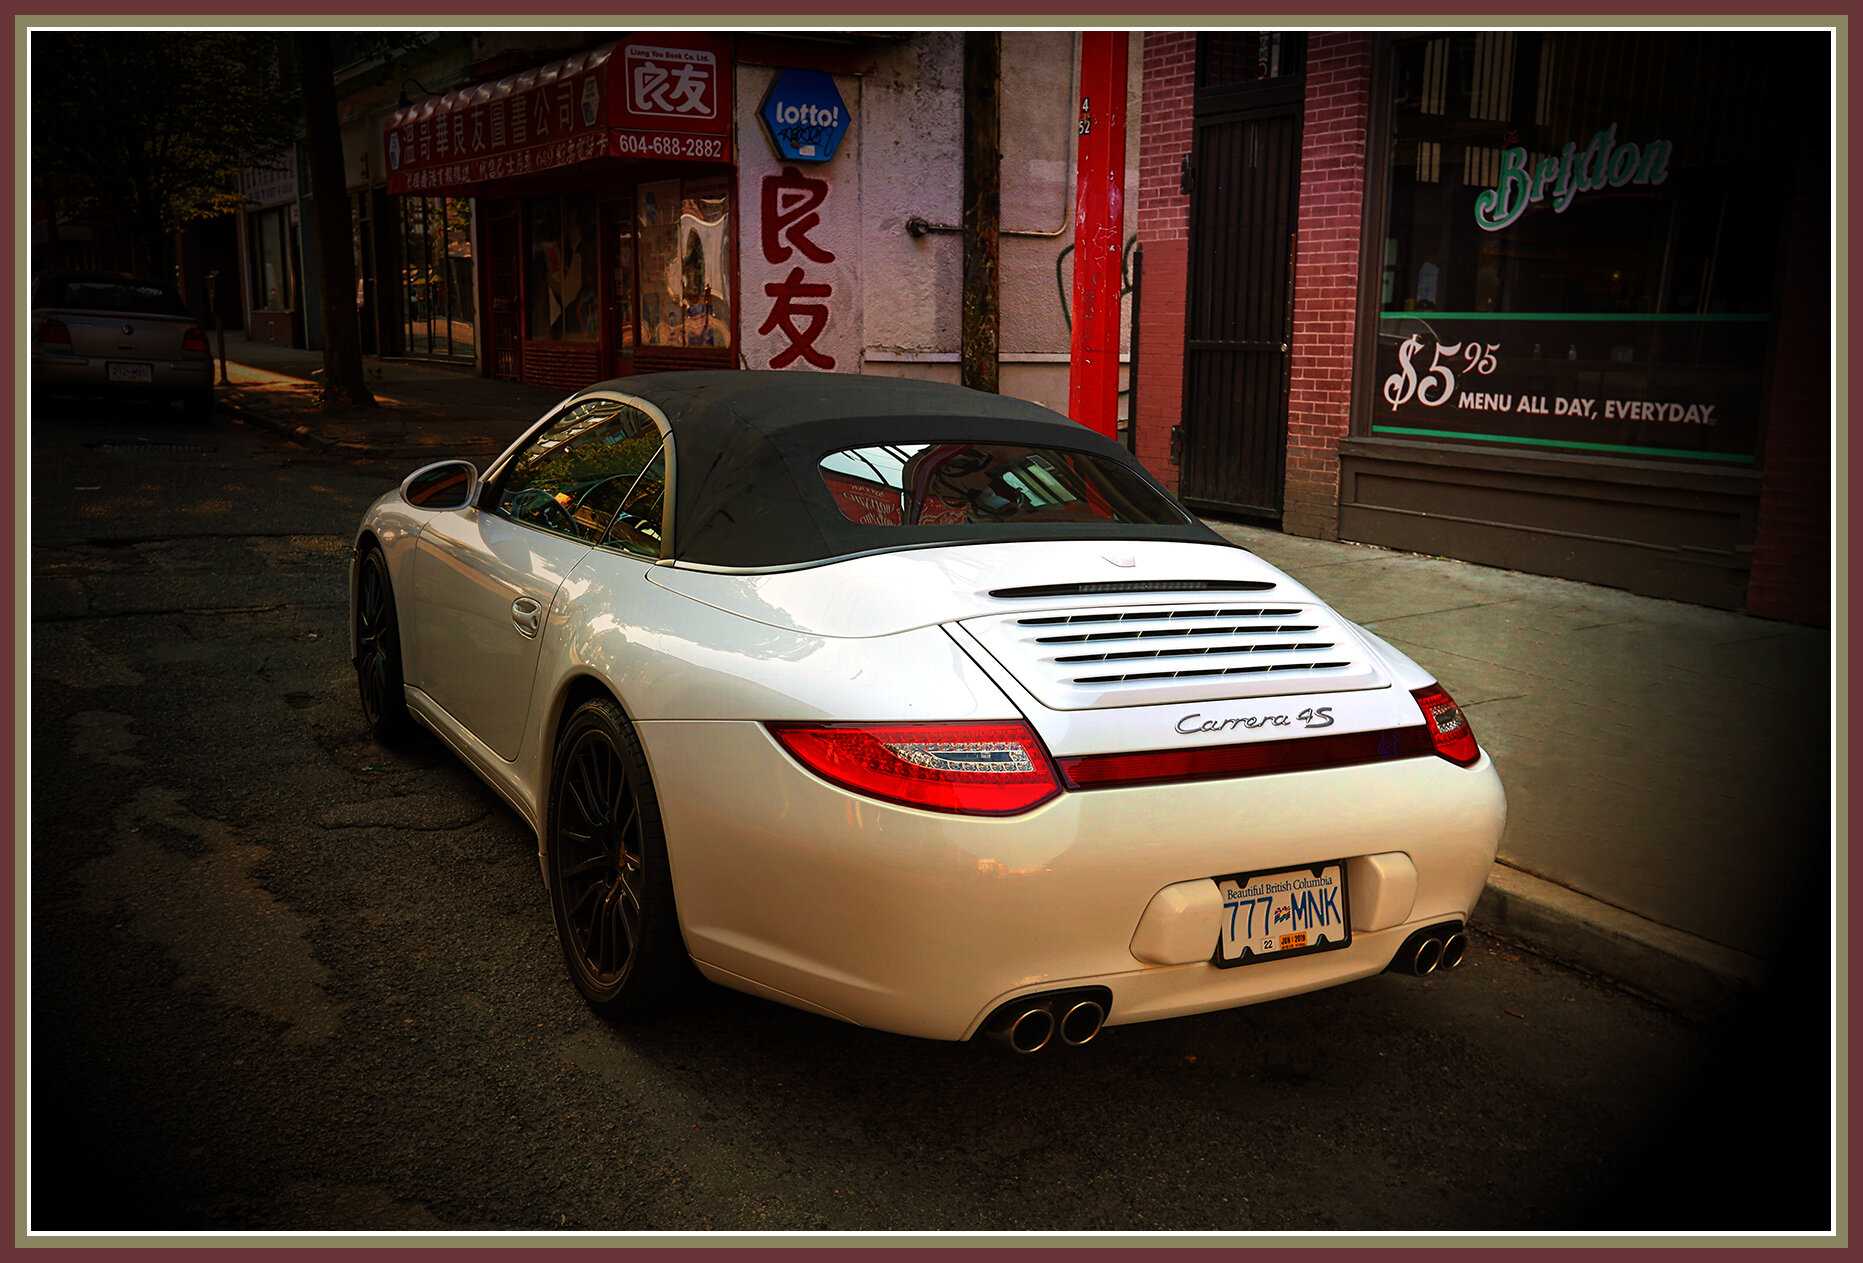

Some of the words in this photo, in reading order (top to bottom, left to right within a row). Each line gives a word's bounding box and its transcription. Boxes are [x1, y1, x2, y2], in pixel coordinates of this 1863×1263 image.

[630, 49, 649, 58] Liang
[652, 50, 664, 58] You
[633, 61, 711, 115] 良友
[776, 101, 839, 128] lotto!
[1082, 97, 1090, 112] 4
[1079, 120, 1091, 135] 52
[619, 134, 722, 158] 604-688-2882
[1474, 121, 1674, 232] Brixton
[758, 166, 836, 370] 良友
[1457, 391, 1512, 412] MENU
[1516, 395, 1549, 414] ALL
[1554, 396, 1598, 421] DAY,
[1174, 713, 1291, 734] Carrera
[1296, 706, 1334, 729] 4S
[1227, 885, 1264, 900] Beautiful
[1266, 881, 1292, 895] British
[1293, 876, 1333, 890] Columbia
[1224, 896, 1273, 942] 777
[1291, 886, 1342, 931] MNK
[1263, 940, 1273, 950] 22
